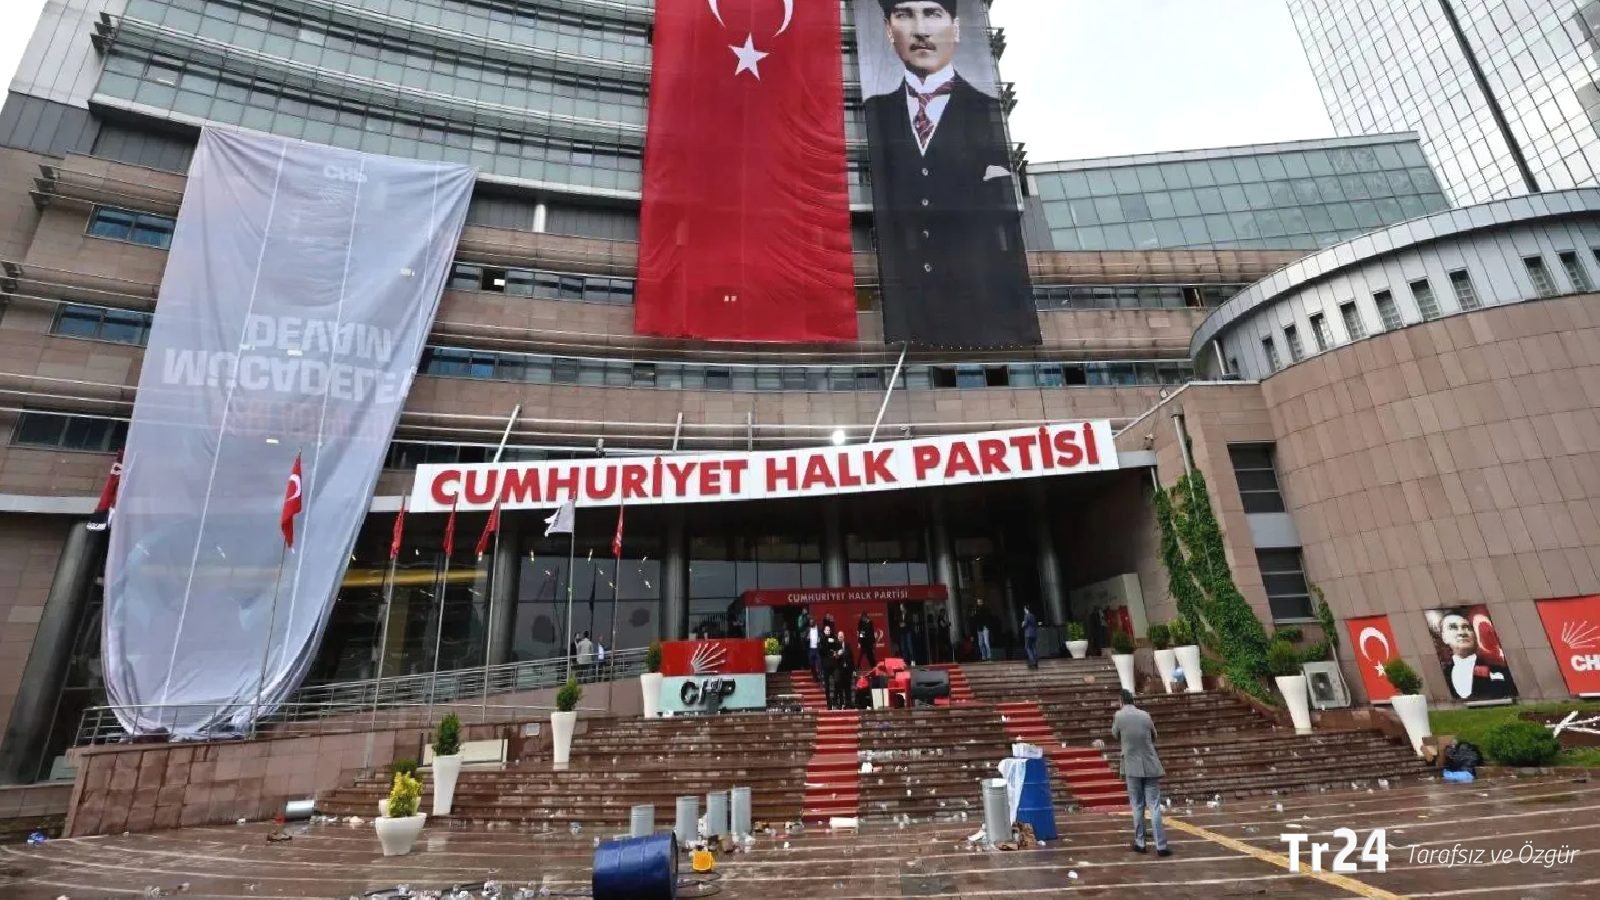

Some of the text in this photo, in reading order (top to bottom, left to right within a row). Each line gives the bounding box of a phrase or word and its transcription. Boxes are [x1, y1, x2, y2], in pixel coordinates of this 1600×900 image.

[431, 421, 1100, 506] CUMHURİYET HALK PARTİSİ
[787, 589, 908, 603] CUMHURİYET HALK PARTİSİ
[1570, 654, 1600, 672] CH
